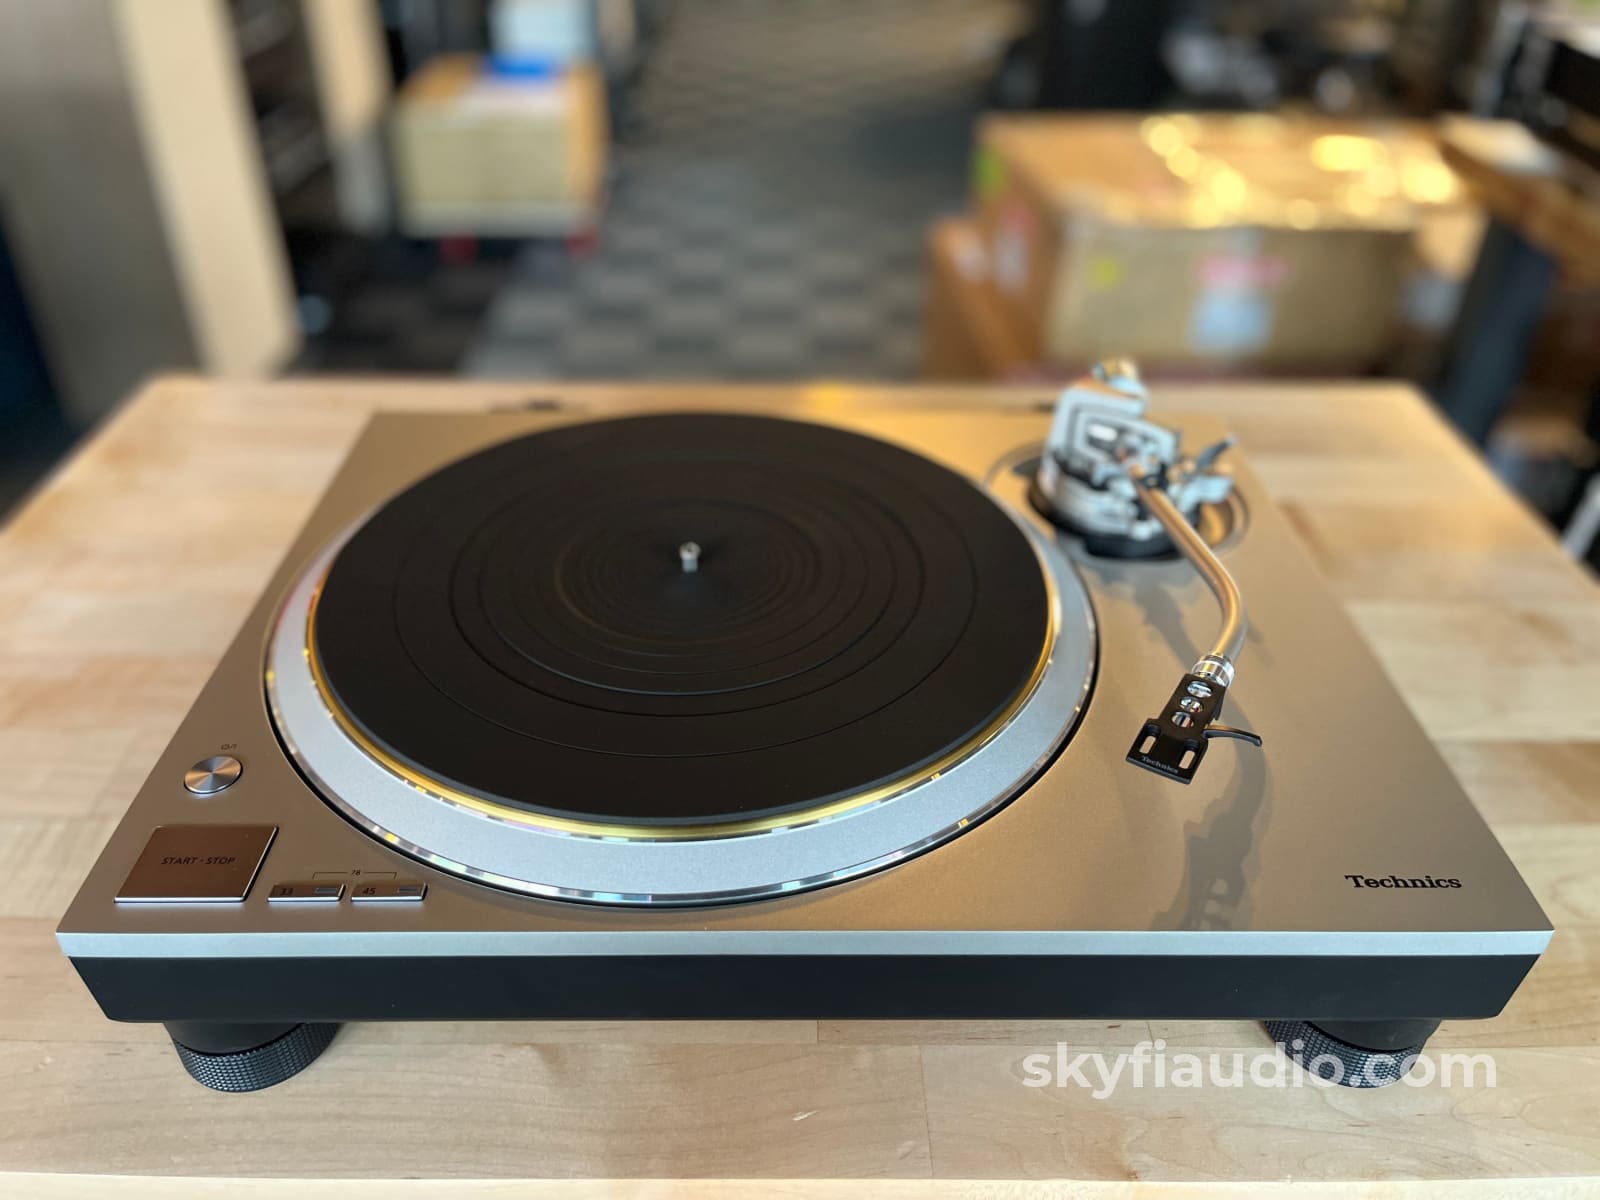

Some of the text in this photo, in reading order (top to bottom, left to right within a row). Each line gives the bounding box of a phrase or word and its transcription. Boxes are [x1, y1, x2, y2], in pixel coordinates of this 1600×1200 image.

[160, 856, 237, 865] START STOP
[1344, 874, 1463, 889] Technics
[361, 887, 377, 895] 45
